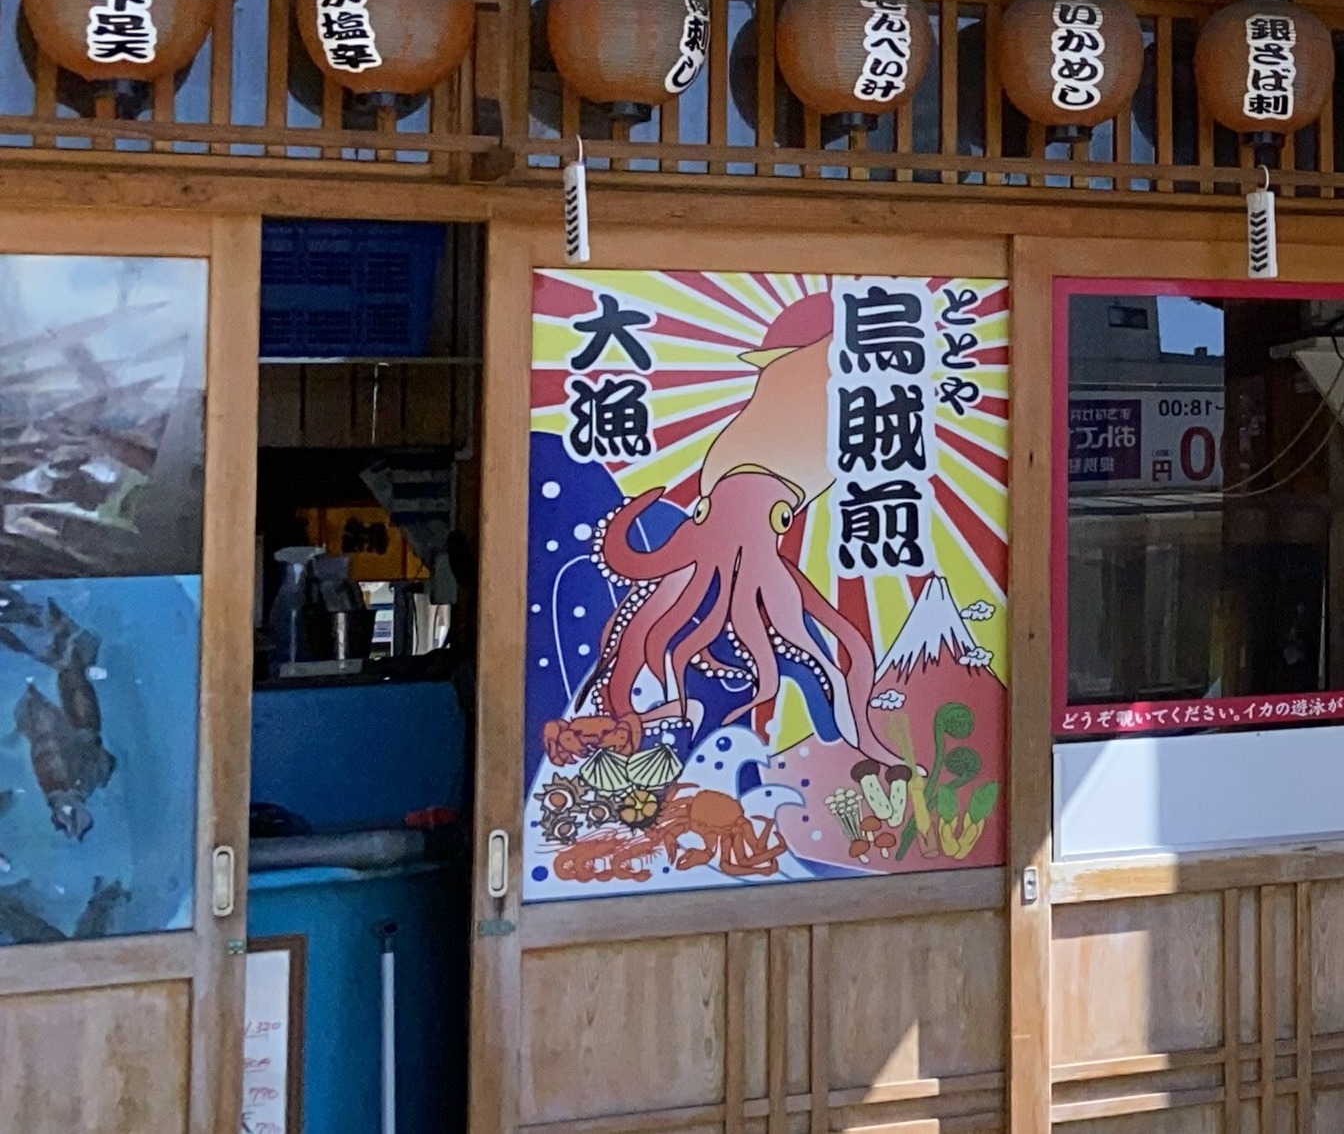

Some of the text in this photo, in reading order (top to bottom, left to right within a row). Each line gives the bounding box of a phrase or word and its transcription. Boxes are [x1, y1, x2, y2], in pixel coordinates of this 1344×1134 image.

[1057, 2, 1100, 107] いかめし
[1248, 17, 1292, 116] 銀さば刺
[568, 293, 652, 457] 大漁
[939, 288, 979, 416] ととや
